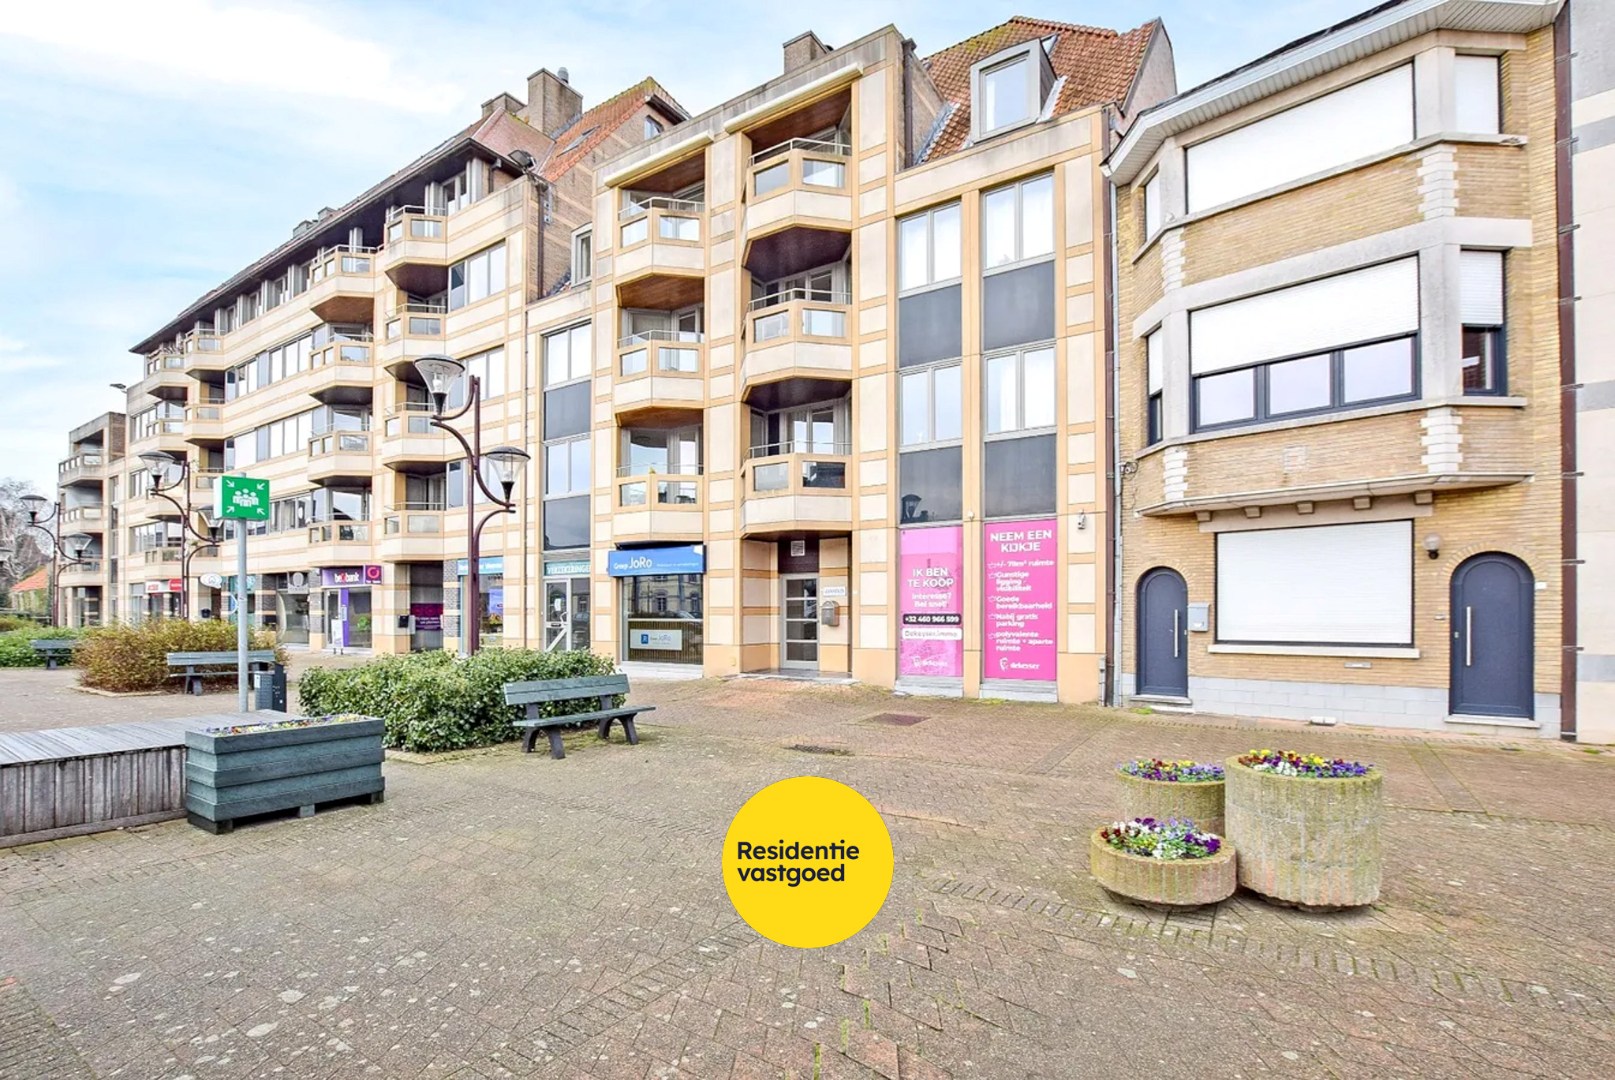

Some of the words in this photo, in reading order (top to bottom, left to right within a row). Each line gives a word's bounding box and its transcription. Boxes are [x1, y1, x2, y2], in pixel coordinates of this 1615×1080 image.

[990, 531, 1024, 542] NEEM
[1027, 529, 1052, 540] EEN
[1001, 541, 1041, 553] KIJKJE
[629, 556, 653, 569] JoRo
[1028, 559, 1054, 567] ruimte
[912, 568, 924, 577] IK
[926, 567, 949, 577] BEN
[907, 579, 921, 588] TE
[922, 577, 954, 588] KOOP
[905, 615, 917, 623] +32
